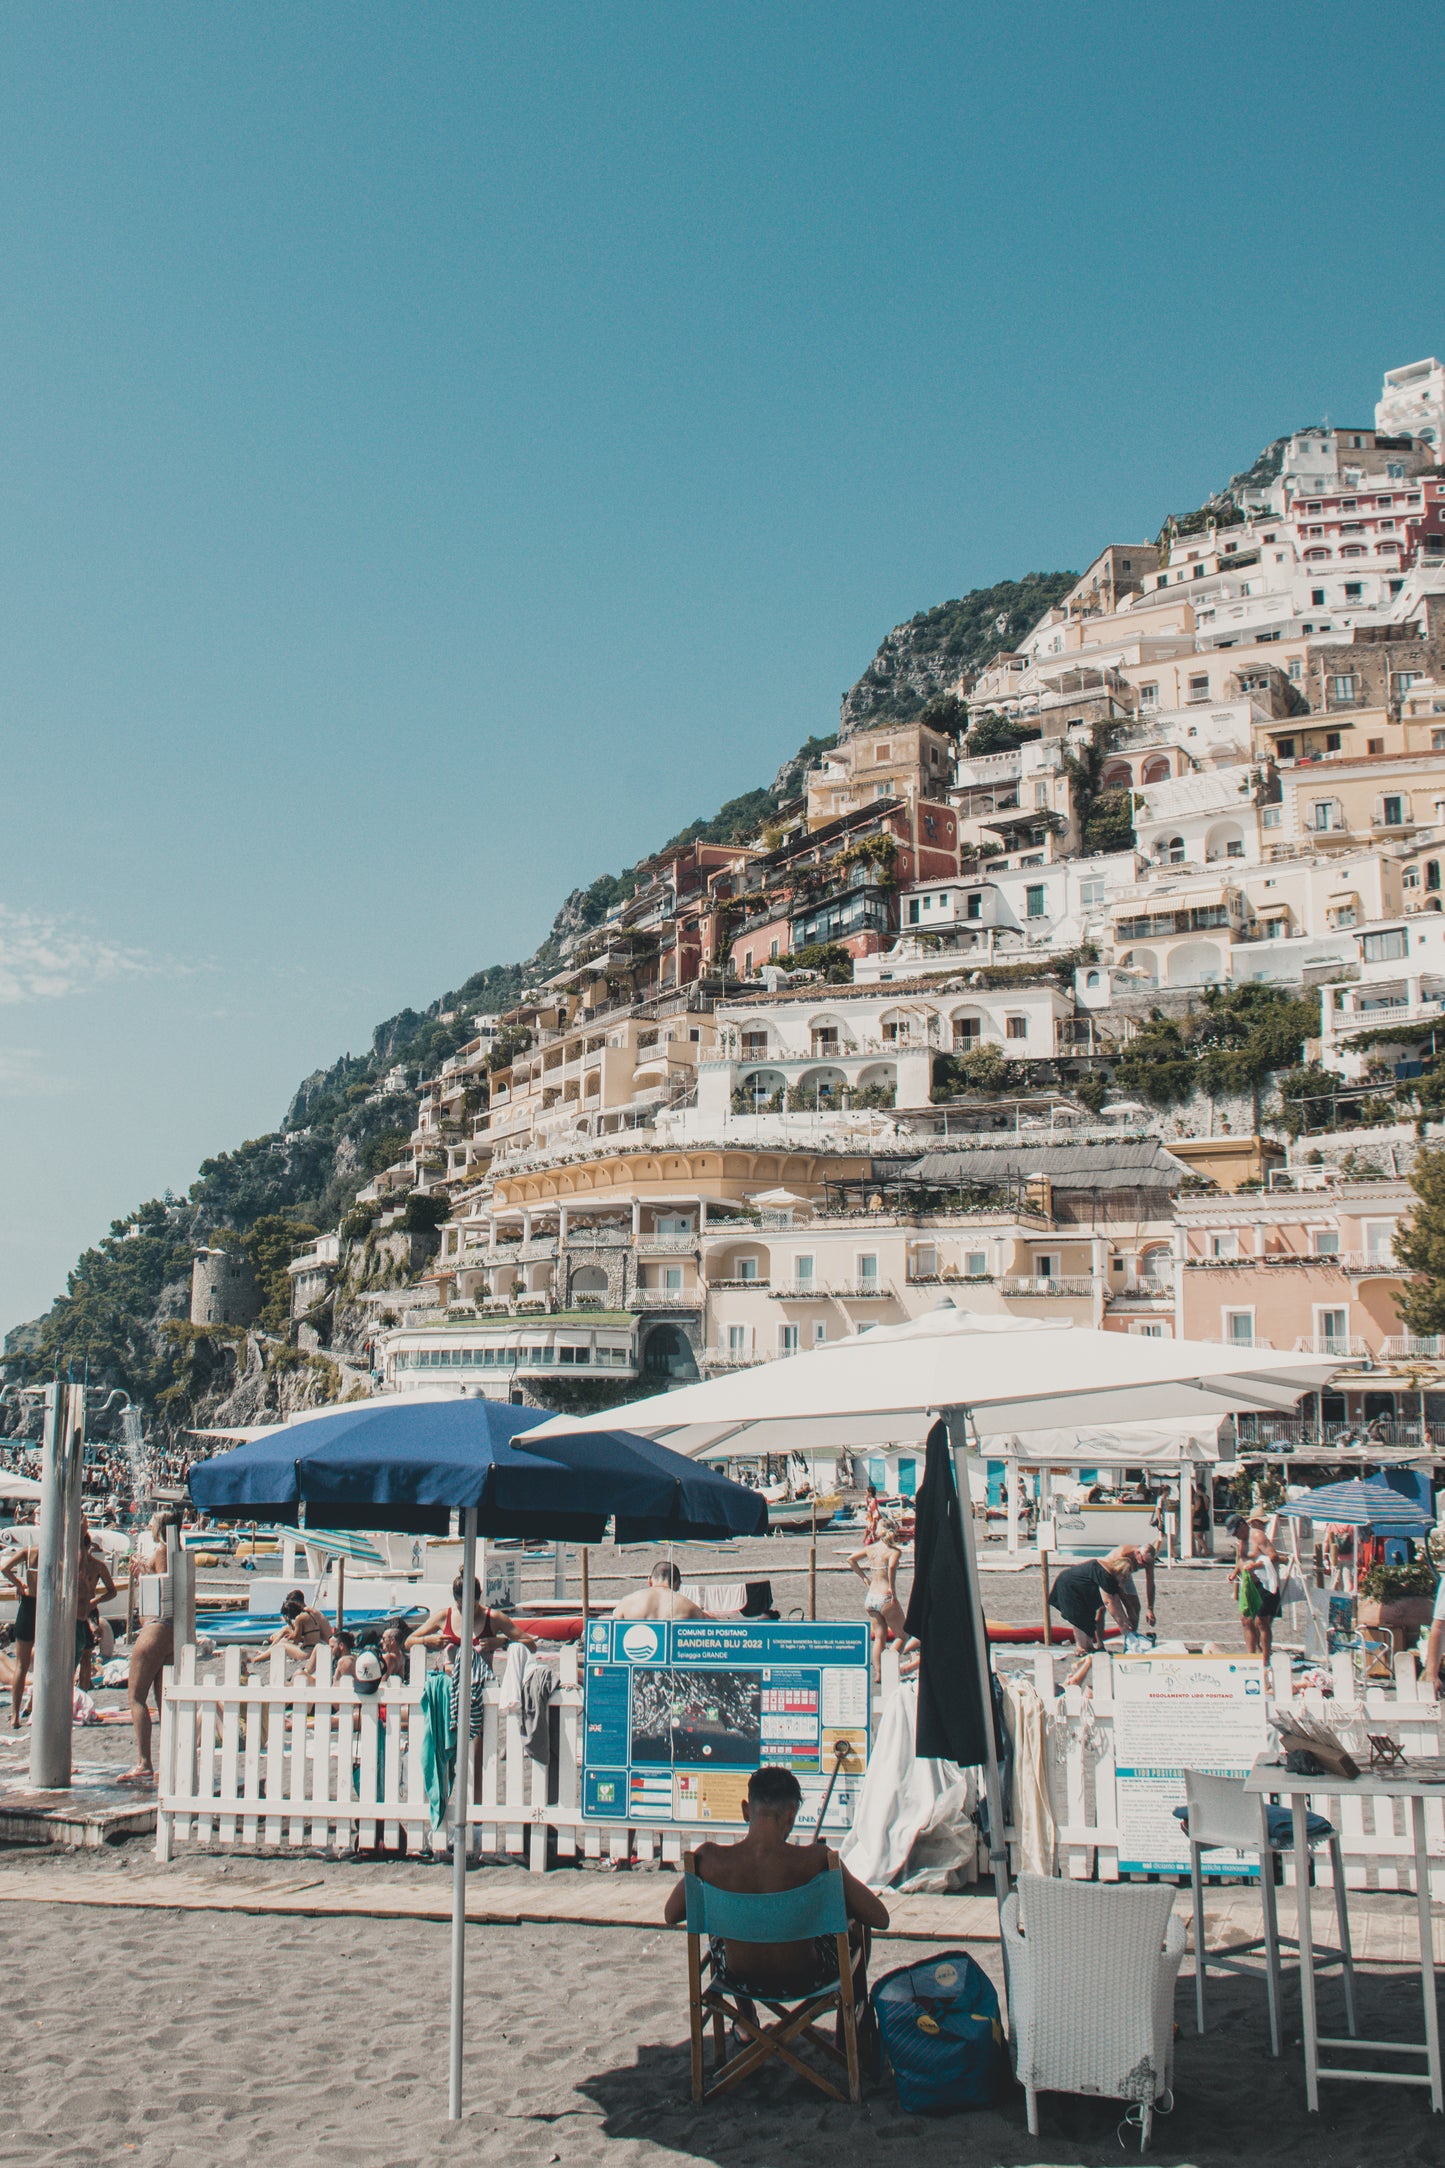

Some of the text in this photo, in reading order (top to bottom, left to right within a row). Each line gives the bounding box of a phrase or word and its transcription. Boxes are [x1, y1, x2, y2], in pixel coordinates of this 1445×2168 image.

[715, 1629, 748, 1637] POSITANO
[589, 1643, 608, 1654] FEE
[677, 1639, 763, 1649] BANDIERA BLU 2022
